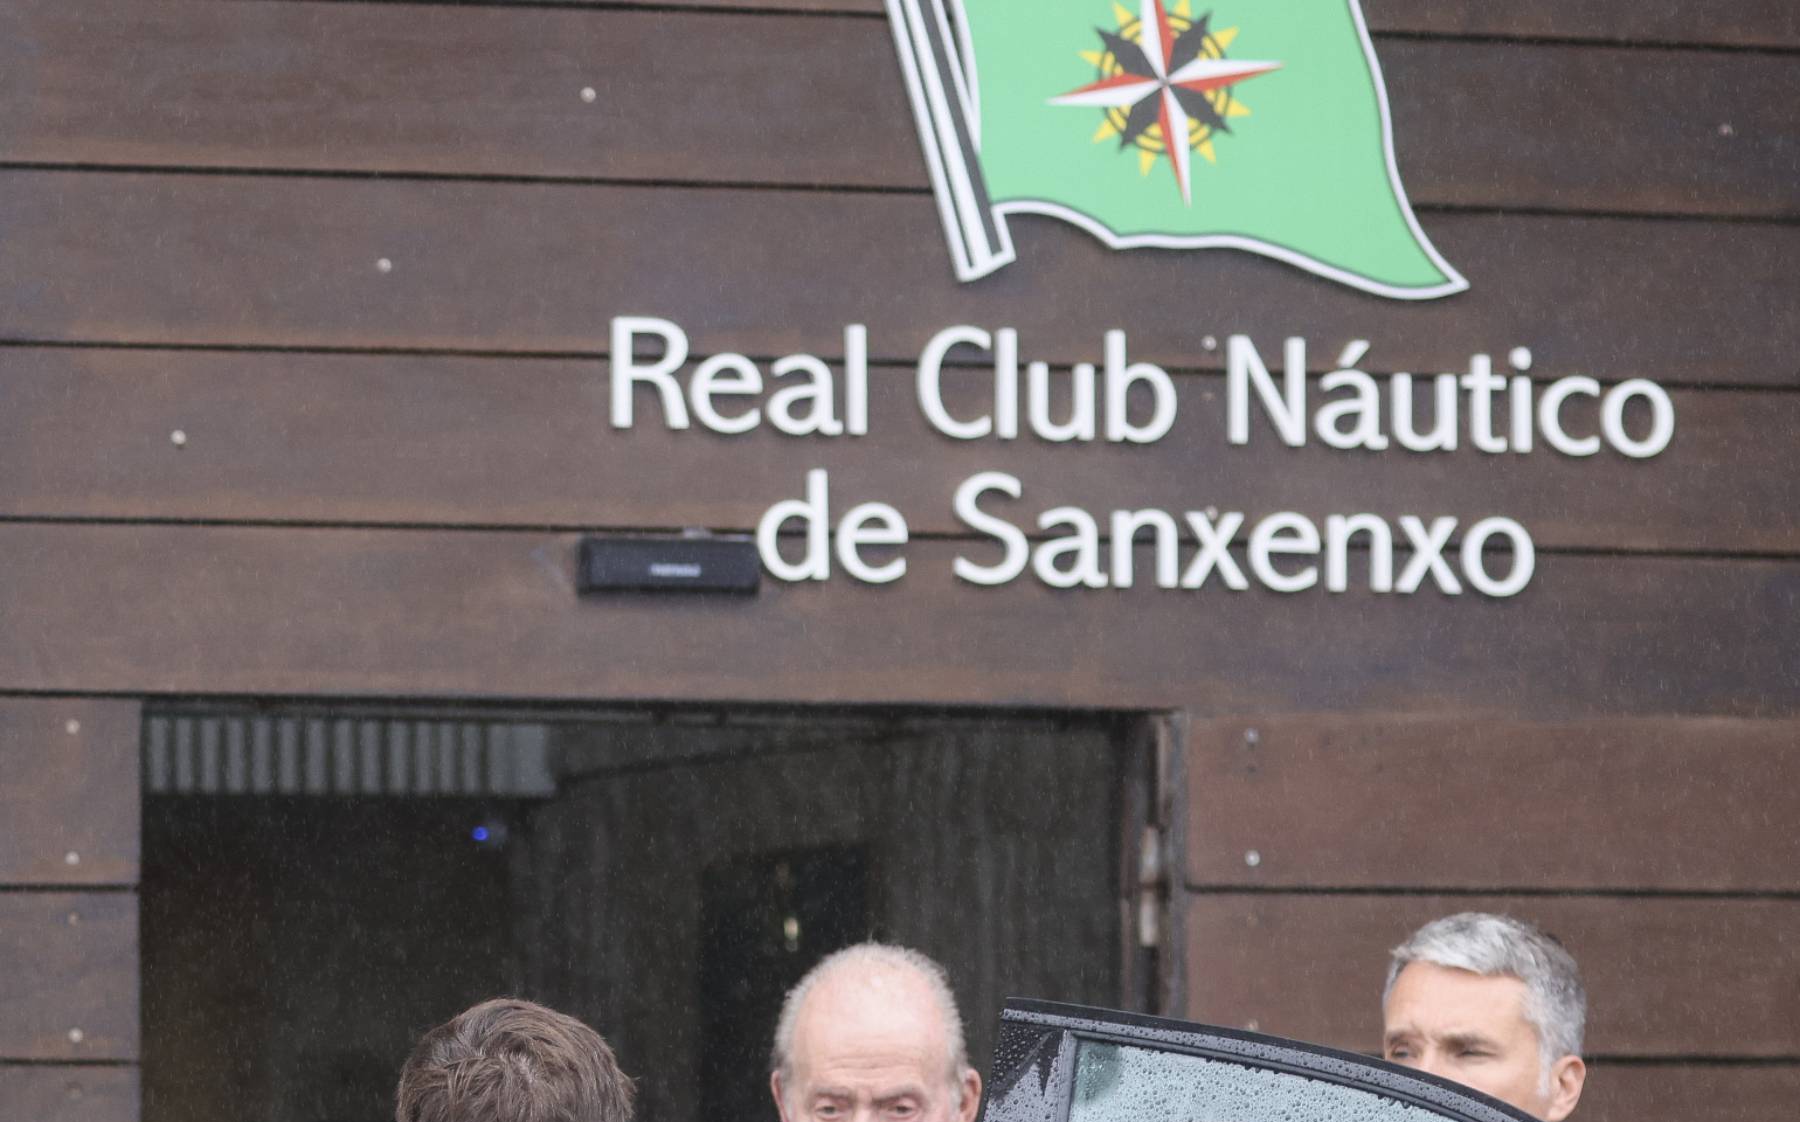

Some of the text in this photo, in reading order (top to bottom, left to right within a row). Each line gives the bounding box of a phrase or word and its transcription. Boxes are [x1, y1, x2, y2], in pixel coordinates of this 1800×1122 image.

[610, 315, 1675, 458] Real Club Náutico
[756, 467, 1535, 597] de Sanxenxo
